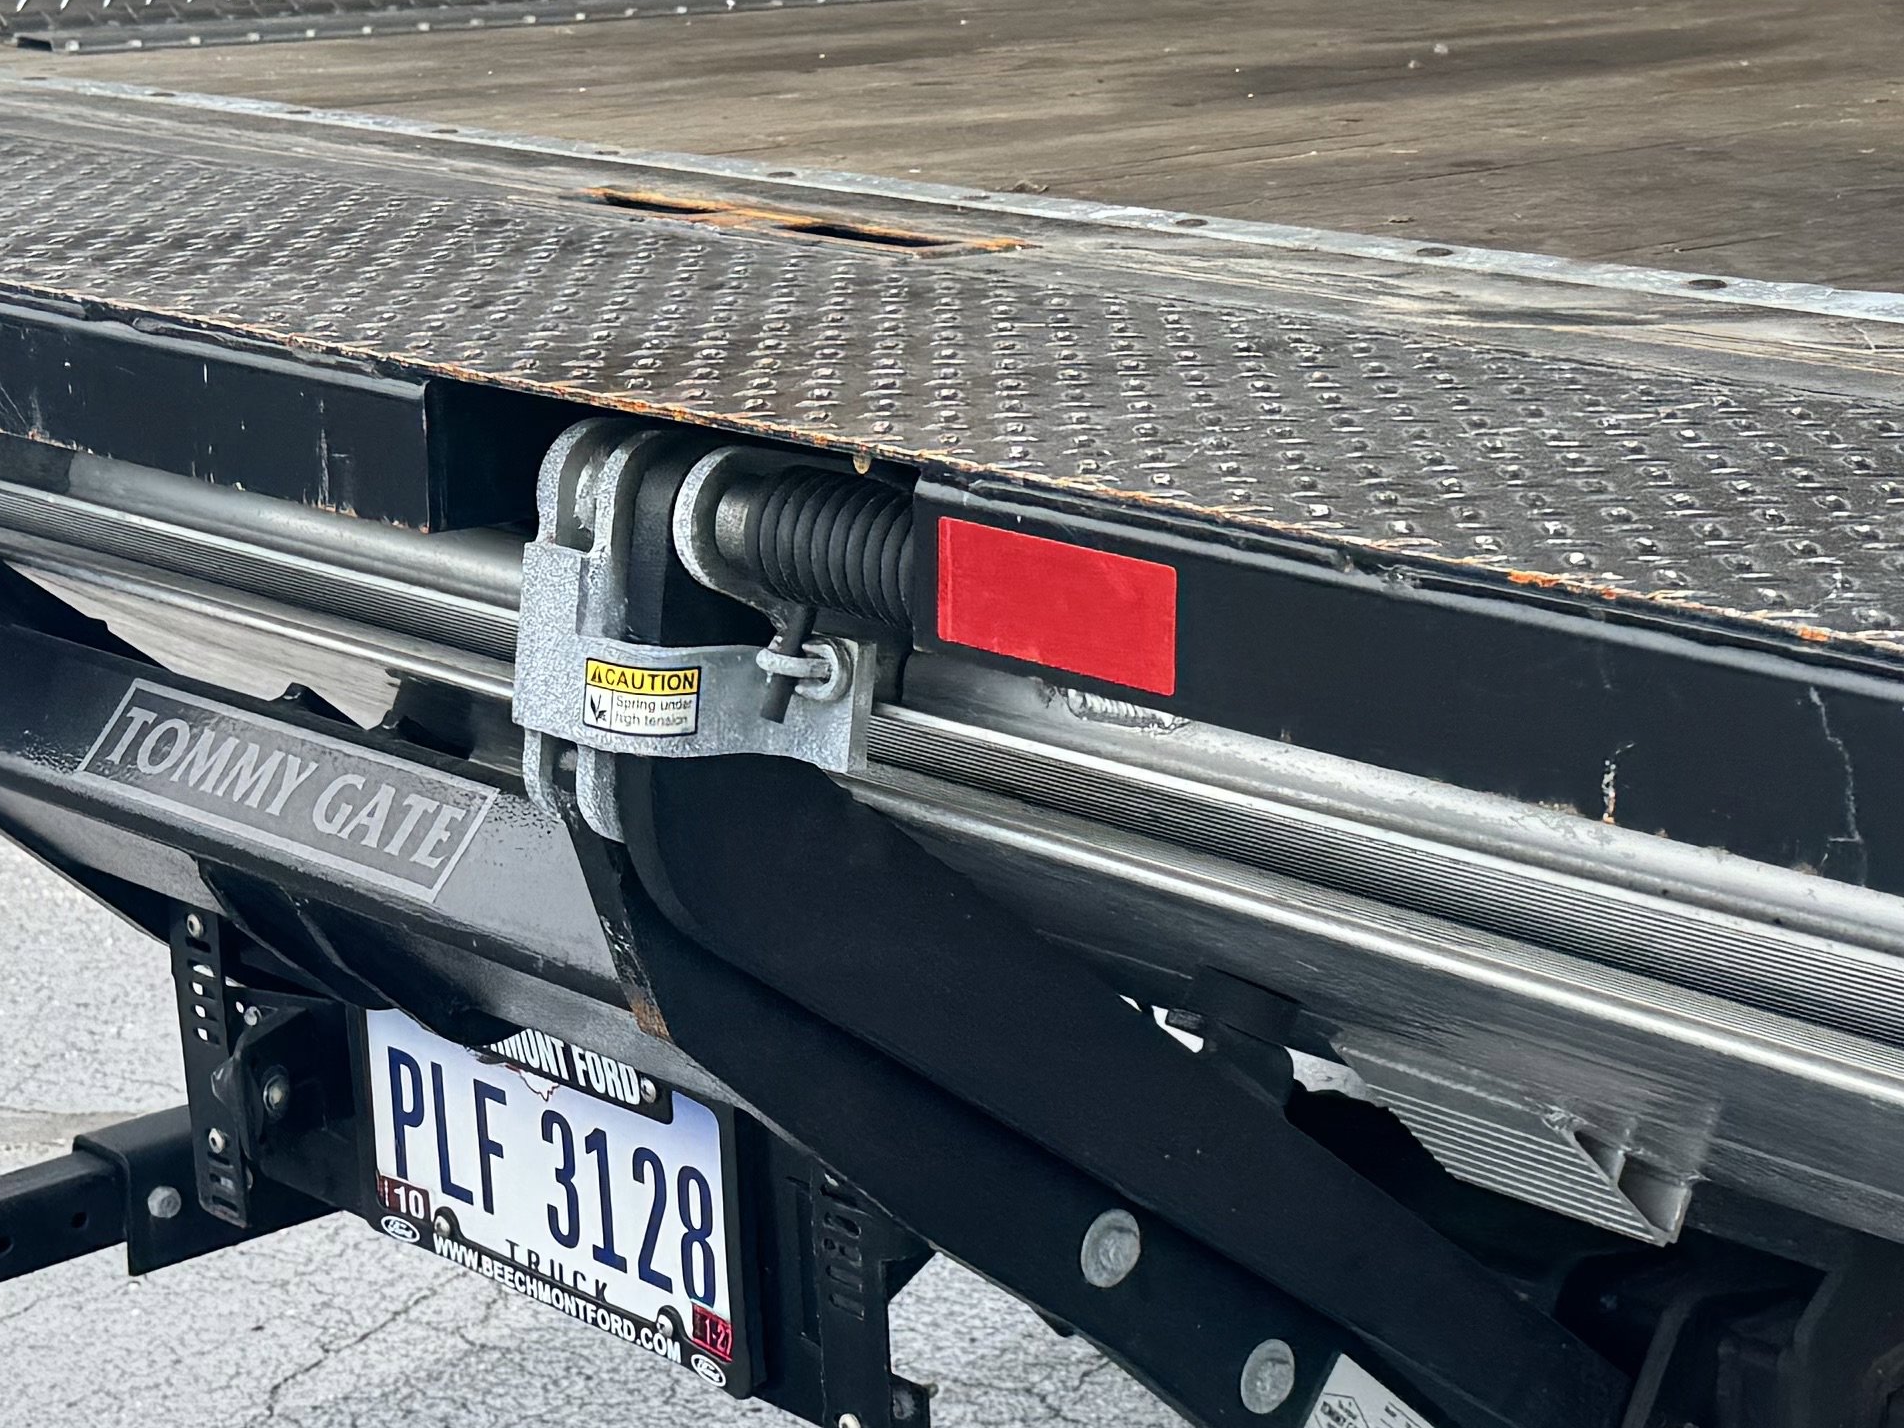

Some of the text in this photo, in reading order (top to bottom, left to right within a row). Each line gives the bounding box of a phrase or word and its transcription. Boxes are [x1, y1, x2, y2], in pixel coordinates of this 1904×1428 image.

[605, 668, 695, 691] CAUTION
[615, 713, 688, 727] high tension
[616, 695, 693, 713] Spring under
[104, 706, 468, 870] TOMMY GATE
[571, 1044, 640, 1106] FORD
[388, 1046, 715, 1309] PLF 3128
[394, 1186, 425, 1220] 10
[384, 1217, 417, 1240] Ford
[505, 1239, 608, 1303] TRUCK
[433, 1234, 682, 1364] WWW.BEECHMONTFORD.COM
[694, 1357, 723, 1384] Ford
